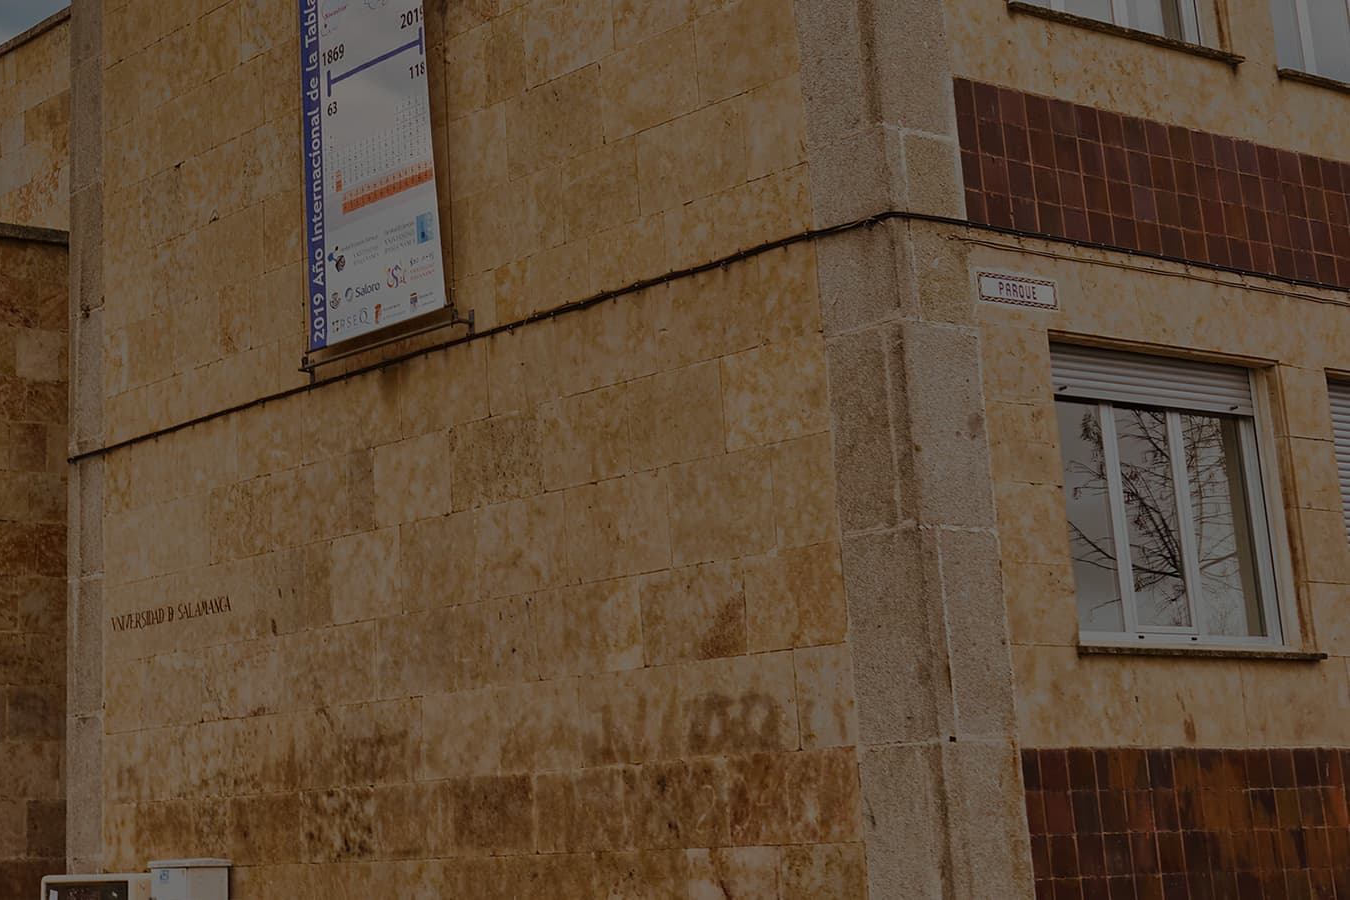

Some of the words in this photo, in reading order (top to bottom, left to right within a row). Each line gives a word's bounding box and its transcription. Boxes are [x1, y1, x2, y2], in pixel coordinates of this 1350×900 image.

[305, 51, 317, 72] la
[322, 44, 345, 66] 1869
[409, 61, 425, 79] 118
[306, 77, 319, 101] de
[327, 101, 338, 116] 63
[307, 107, 323, 242] Internacional
[312, 247, 324, 286] Año
[355, 281, 381, 298] Saloro
[998, 281, 1038, 300] PARQUE
[313, 293, 326, 343] 2019
